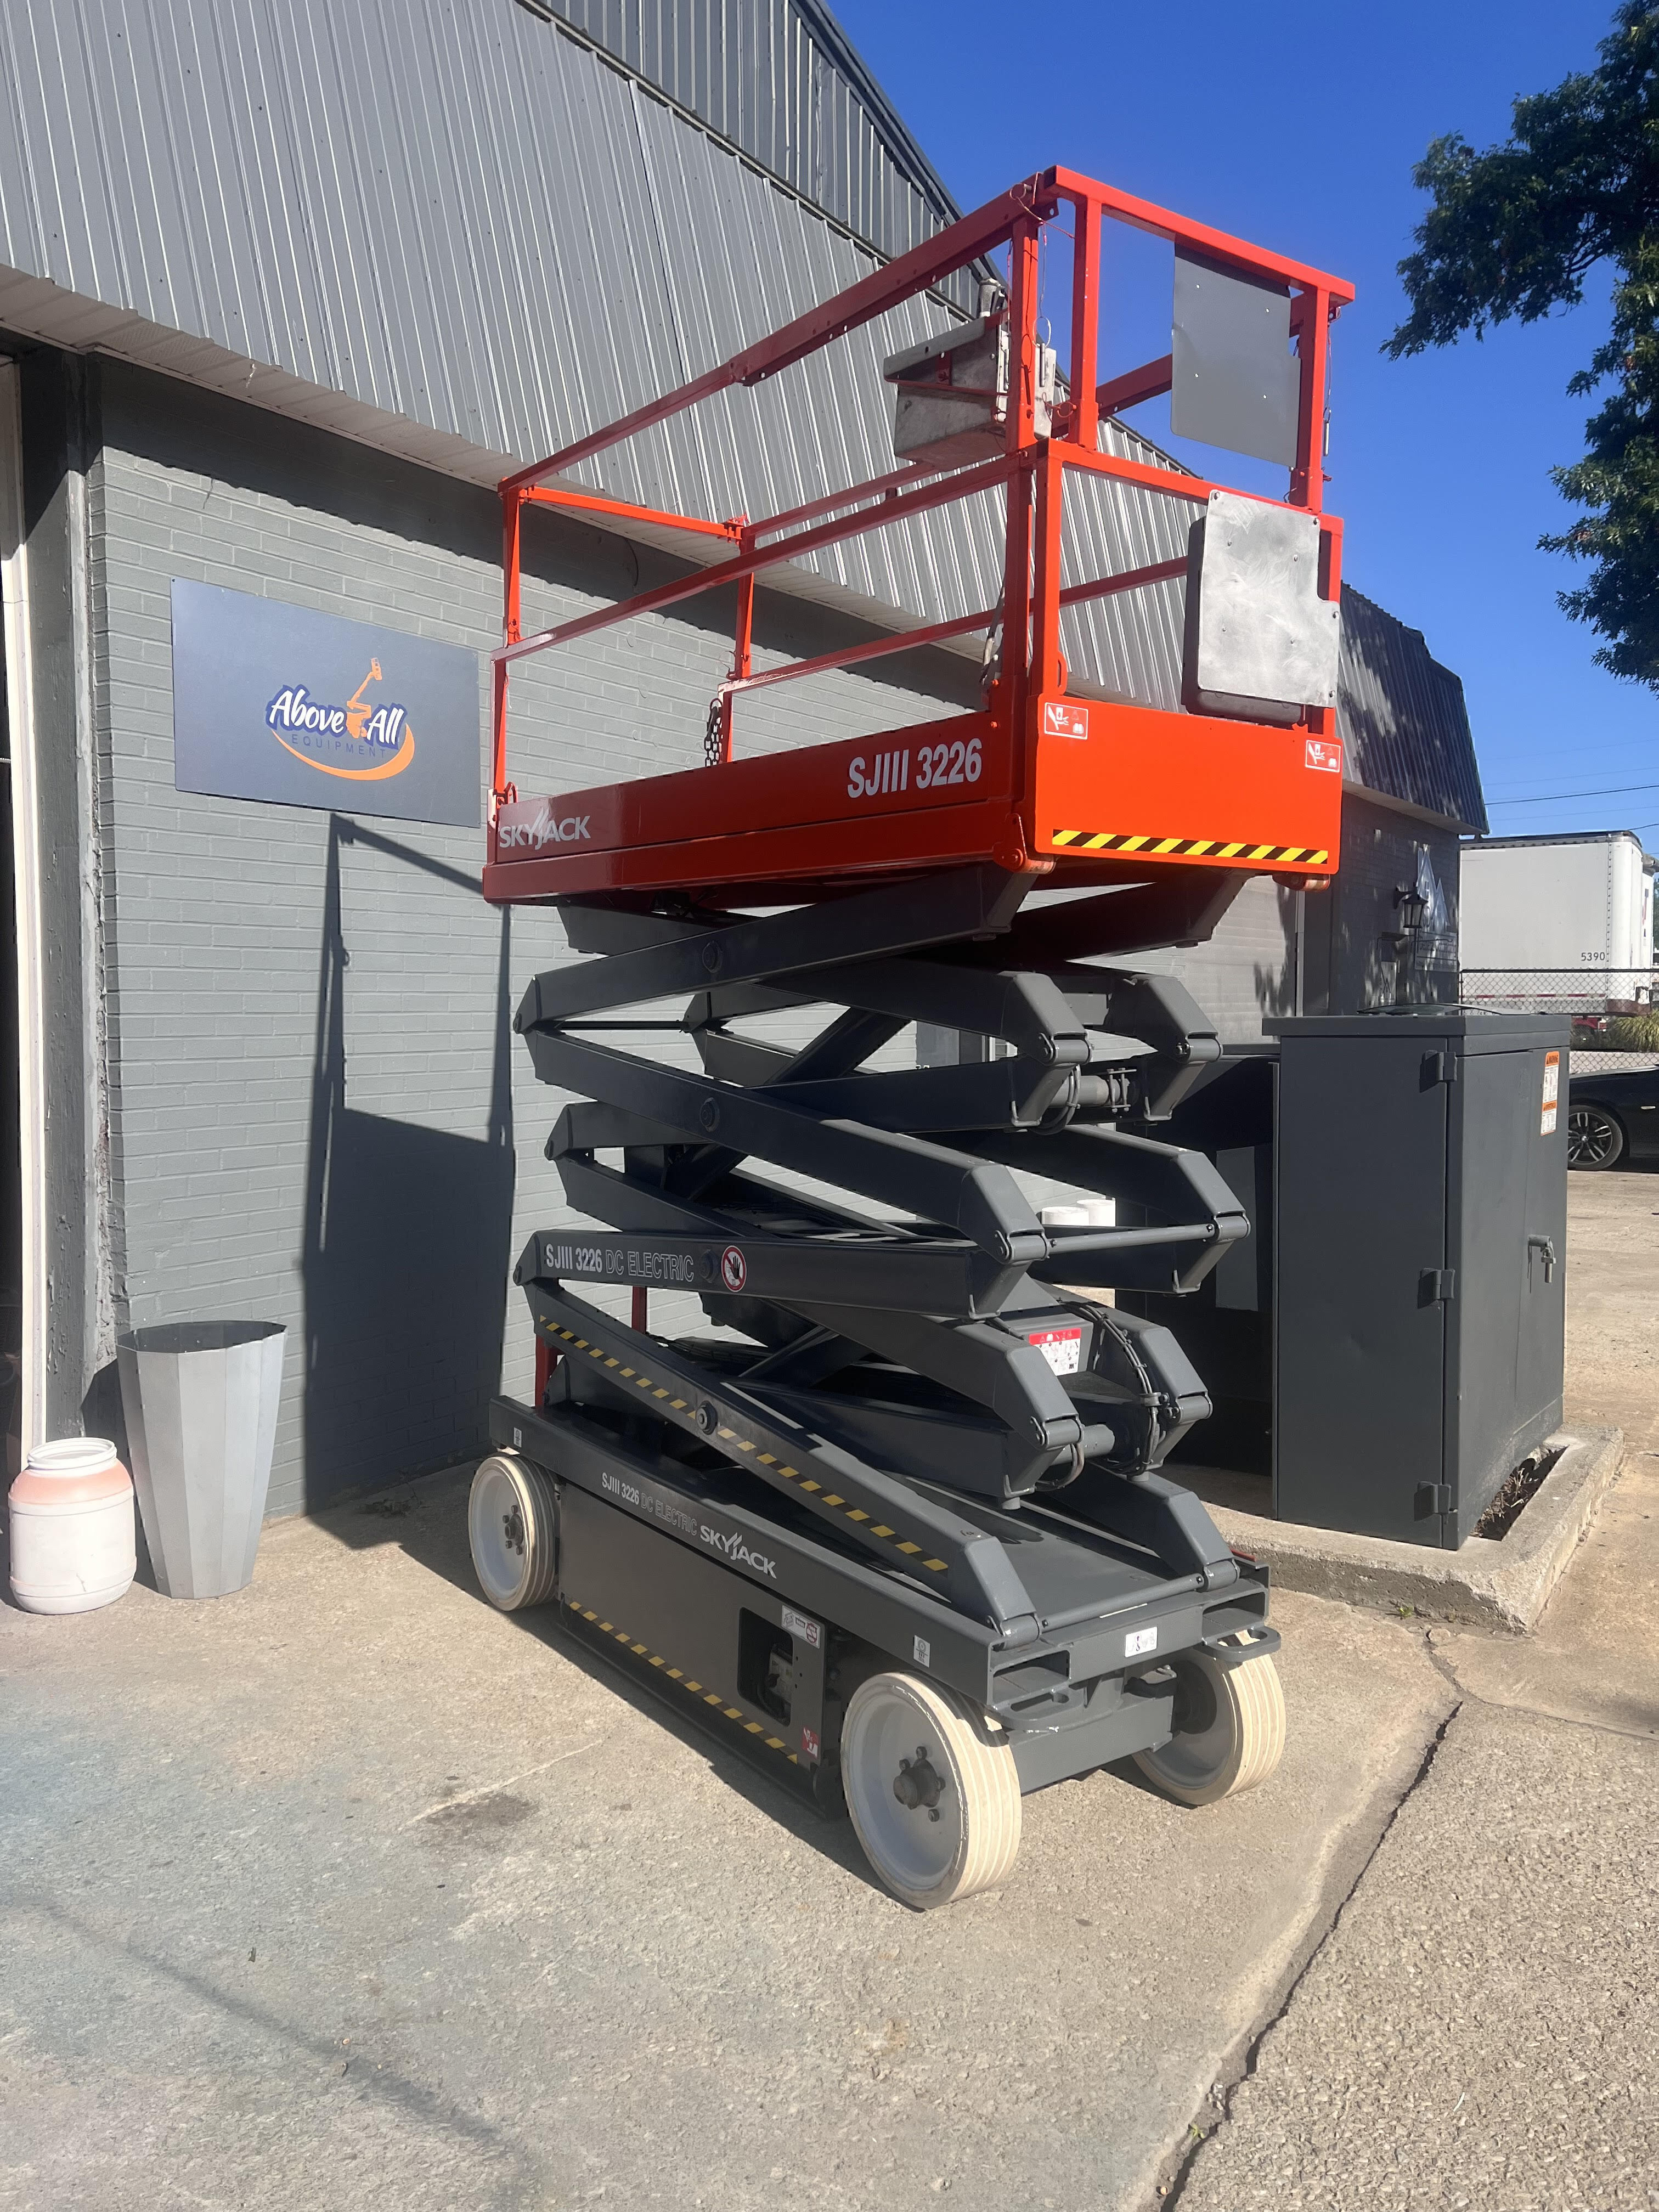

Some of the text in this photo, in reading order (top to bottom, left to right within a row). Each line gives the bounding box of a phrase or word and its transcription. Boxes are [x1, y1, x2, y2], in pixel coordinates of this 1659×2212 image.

[269, 689, 404, 745] Above All
[291, 734, 386, 758] EQUIPMENT
[848, 738, 983, 798] SJIII 3226
[499, 807, 591, 850] SKYJACK
[1581, 952, 1605, 961] 5390
[546, 1244, 694, 1282] SJIII 3226 DC ELECTRIC
[602, 1472, 777, 1579] SJIII 3226 DC ELECTRIC SKYJACK
